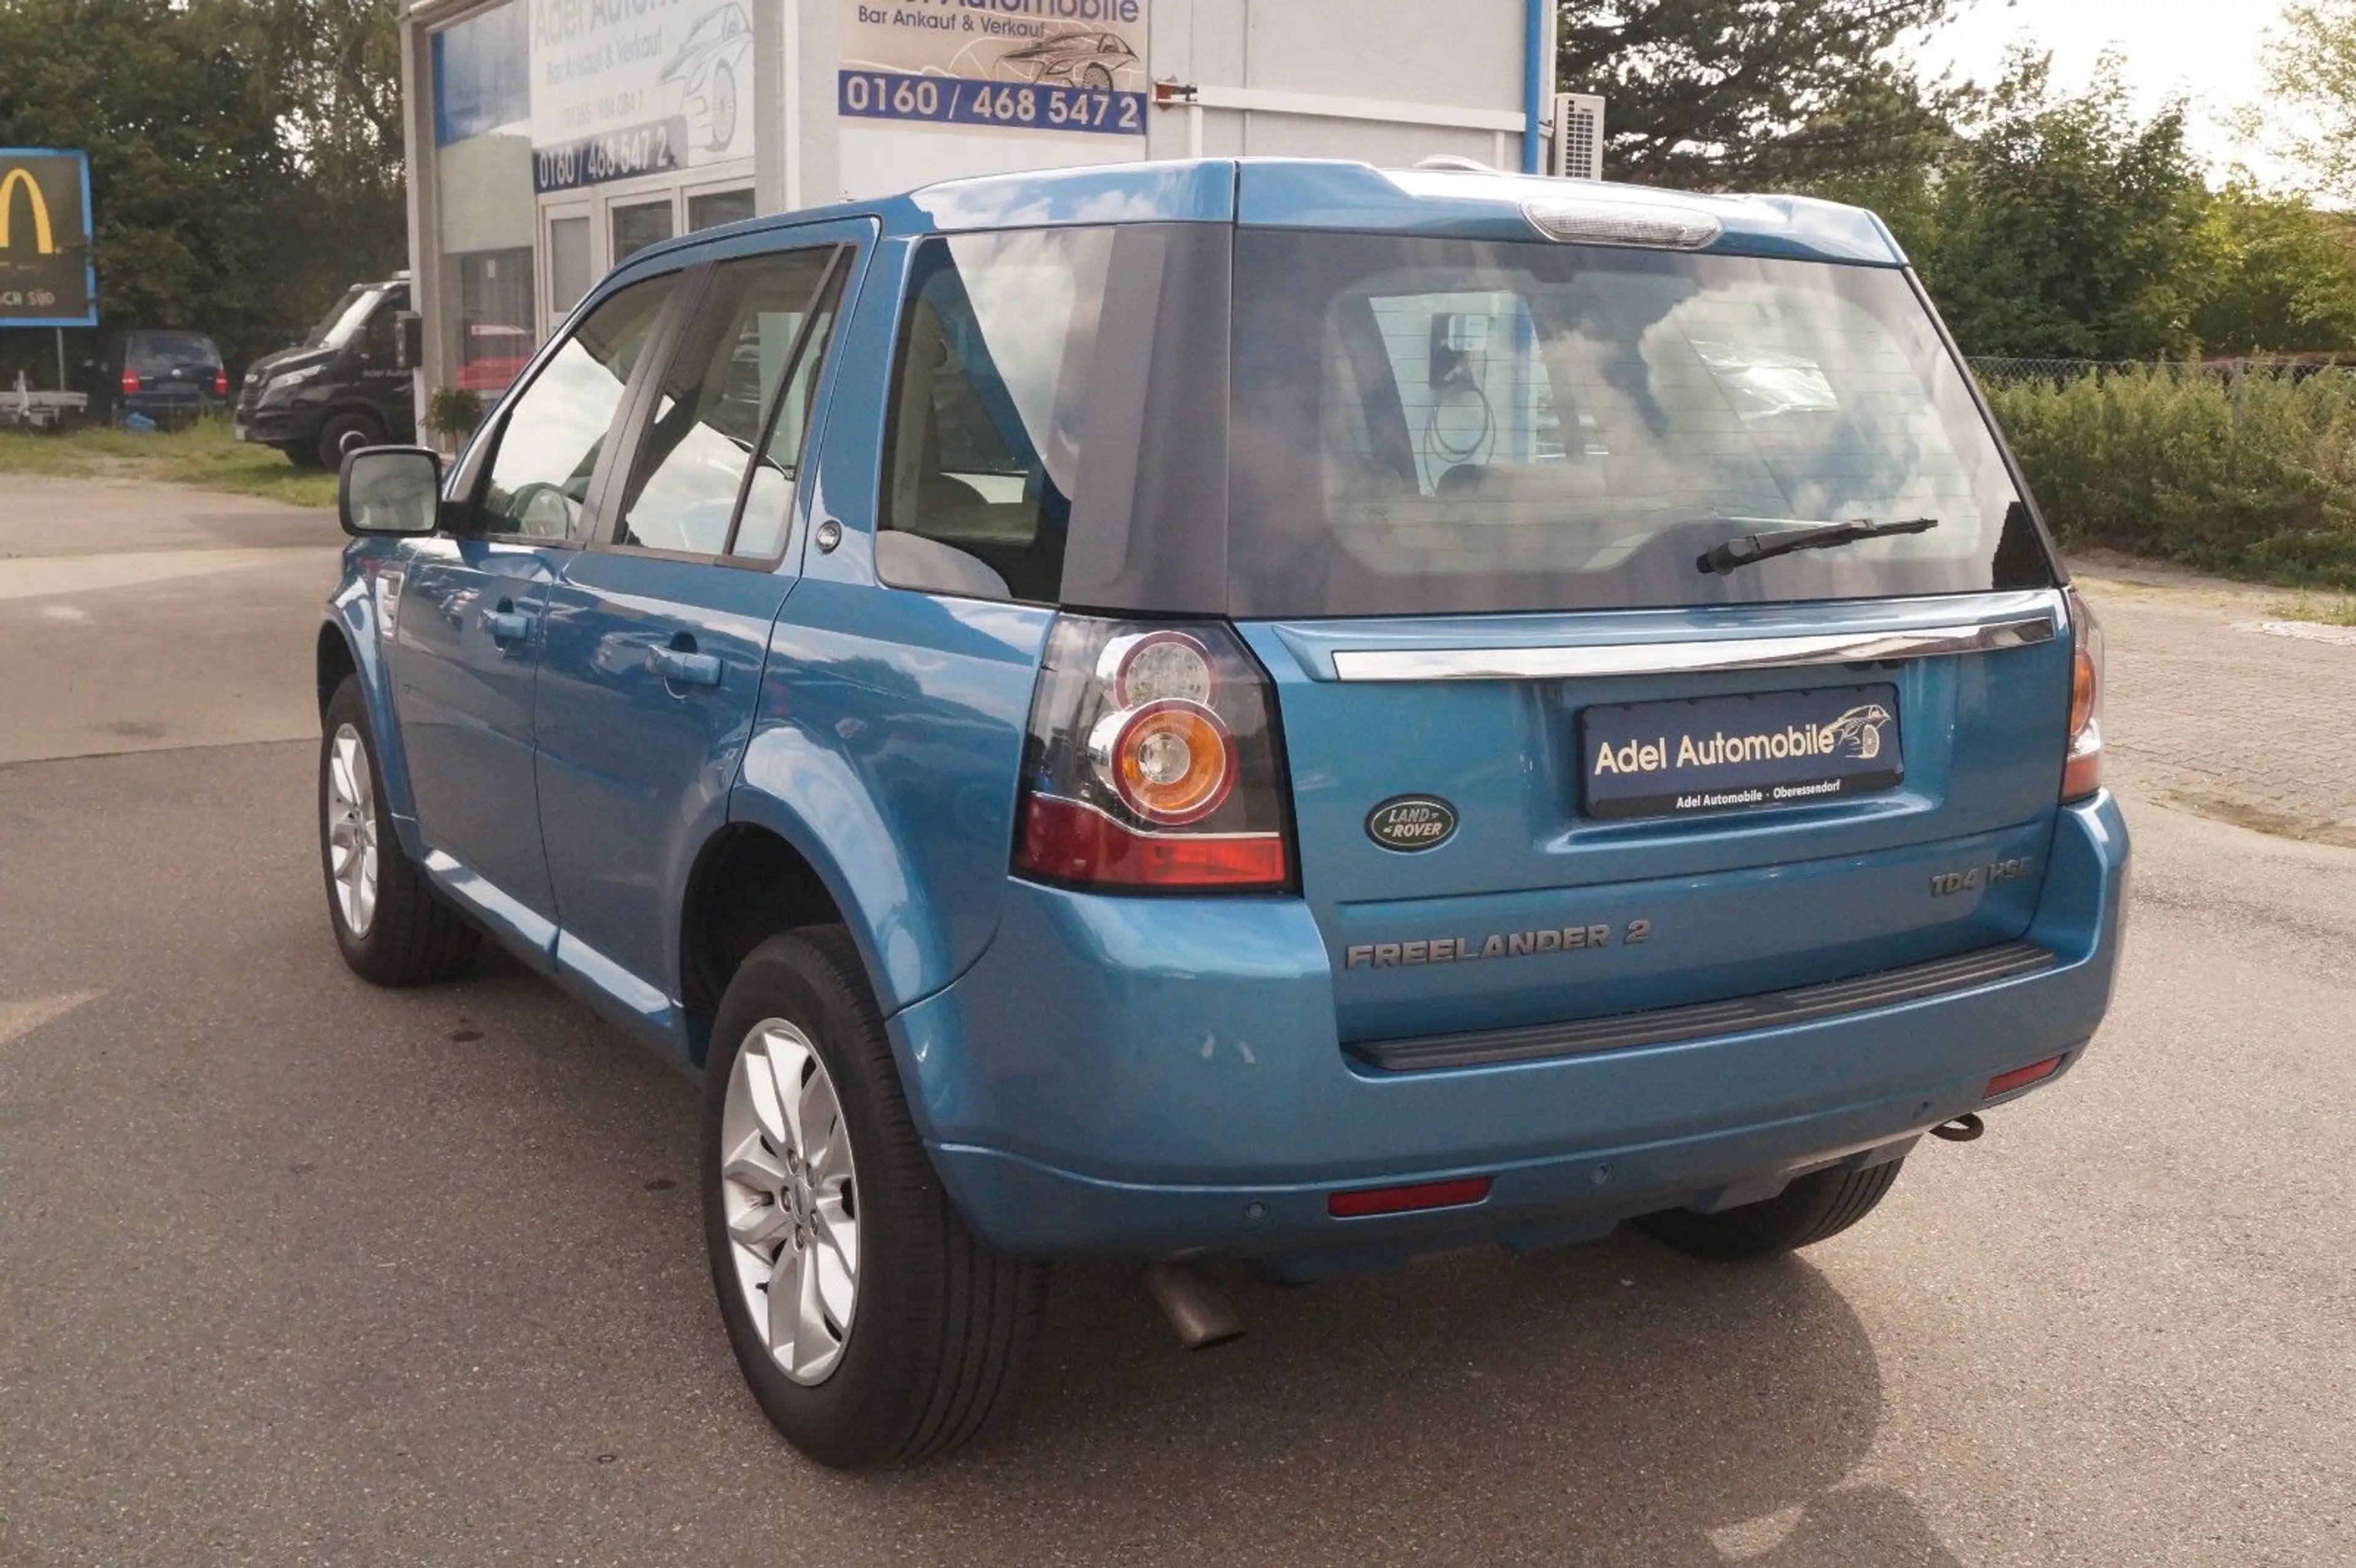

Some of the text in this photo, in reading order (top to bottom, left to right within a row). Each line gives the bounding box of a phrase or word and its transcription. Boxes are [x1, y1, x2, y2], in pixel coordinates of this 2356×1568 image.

[858, 6, 887, 25] Bar
[893, 9, 957, 31] Ankauf
[962, 15, 974, 32] &
[941, 0, 1139, 23] mobile
[847, 75, 1138, 128] 0160 / 468 547 2
[587, 139, 615, 180] 468
[620, 129, 651, 174] 547
[655, 125, 669, 167] 2
[1595, 723, 1835, 775] Adel Automobile
[1676, 796, 1701, 809] Adel
[1703, 789, 1763, 807] Automobile
[1773, 778, 1841, 799] Oberessendorf
[1388, 808, 1431, 823] LAND
[1391, 822, 1443, 837] ROVER
[1345, 919, 1652, 970] FREELANDER 2
